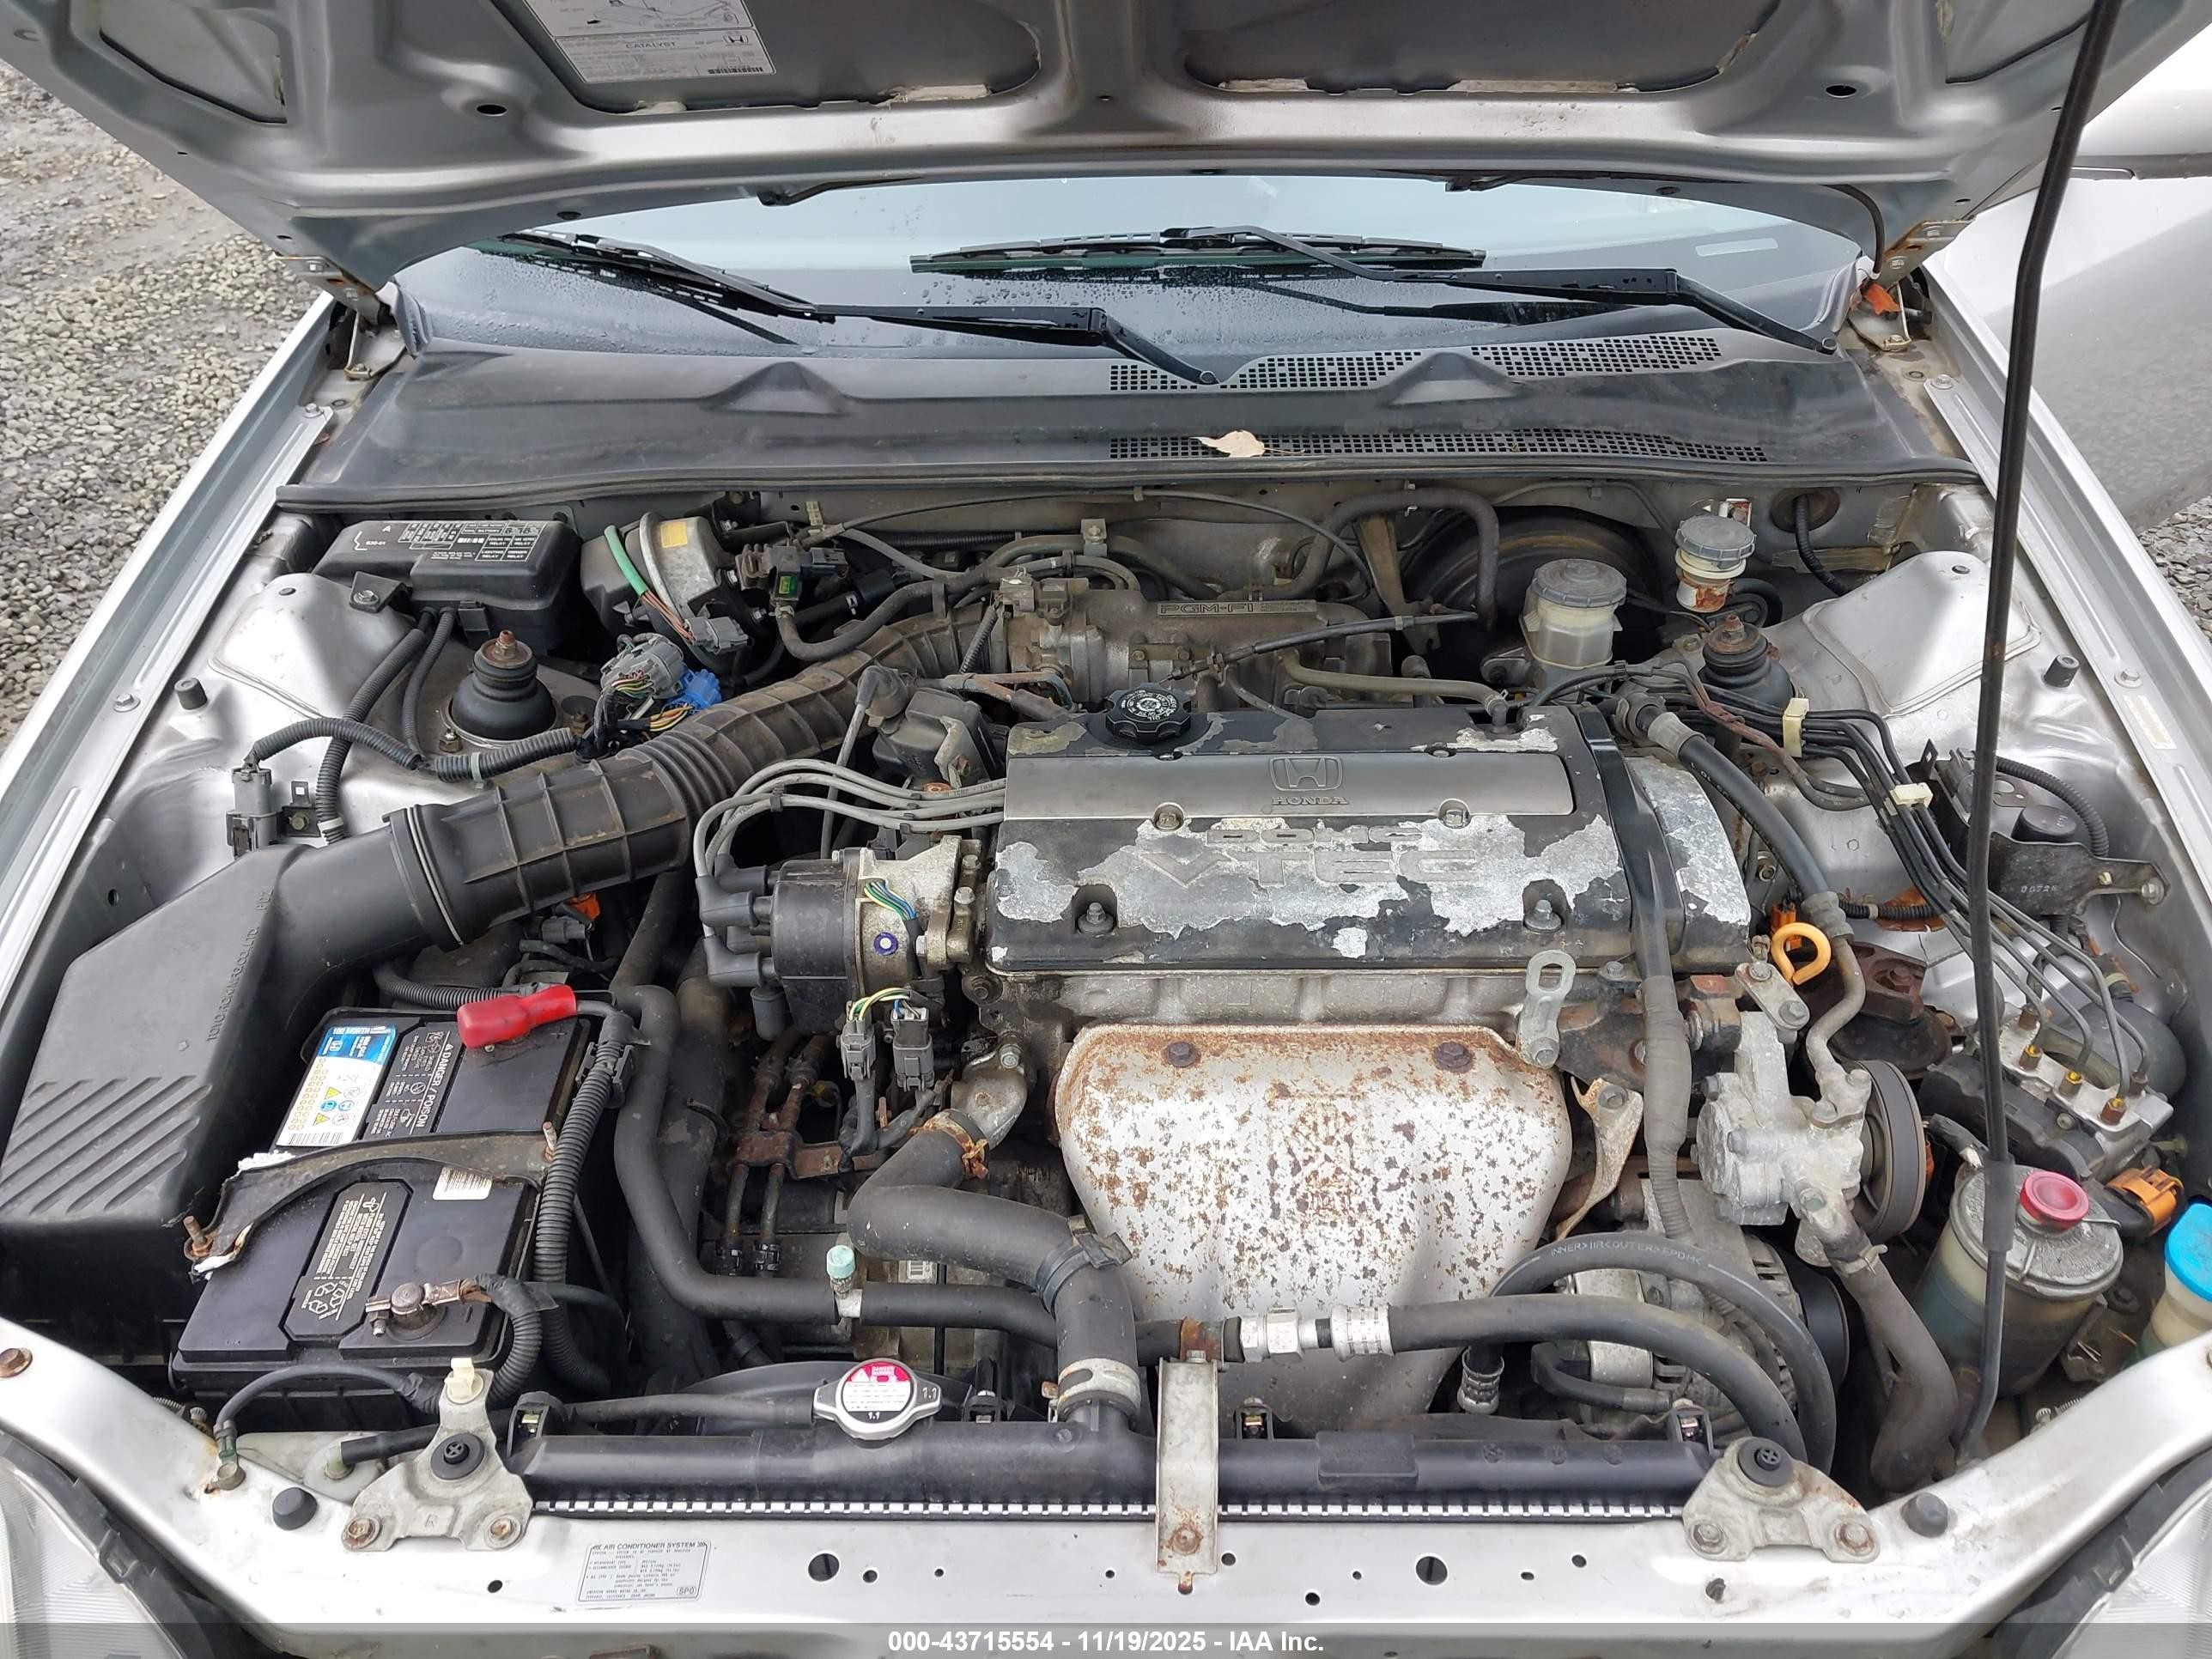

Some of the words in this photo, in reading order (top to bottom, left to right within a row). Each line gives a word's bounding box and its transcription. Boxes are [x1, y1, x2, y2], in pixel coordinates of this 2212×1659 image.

[1160, 603, 1254, 614] PGM-FI
[1272, 797, 1349, 805] HONDA
[1206, 827, 1423, 844] DOHC
[1139, 850, 1478, 887] VTEC
[344, 1026, 370, 1035] MONTH
[432, 1053, 451, 1086] DANGER
[416, 1095, 435, 1127] POISON
[922, 1387, 937, 1400] 1.1
